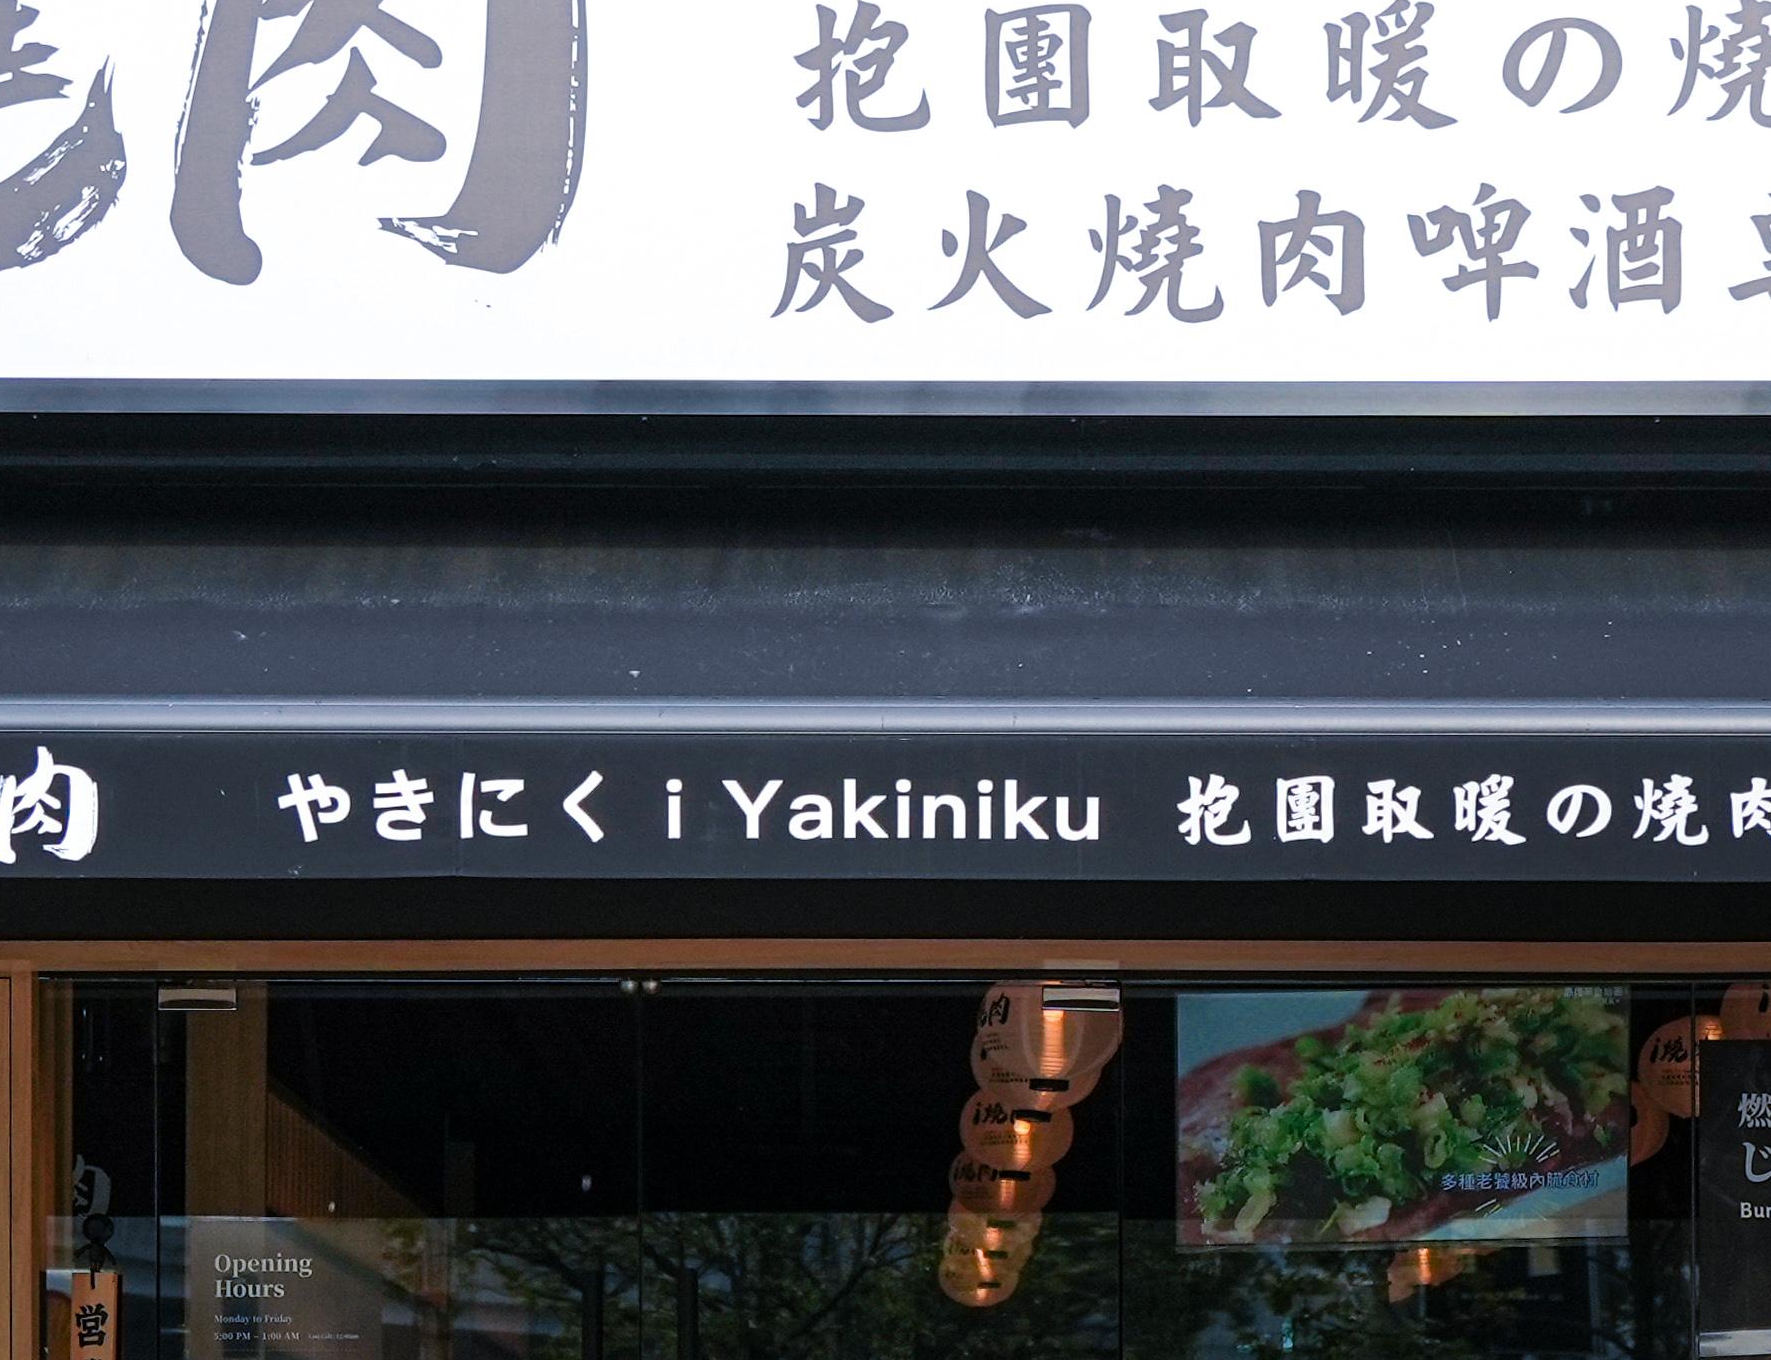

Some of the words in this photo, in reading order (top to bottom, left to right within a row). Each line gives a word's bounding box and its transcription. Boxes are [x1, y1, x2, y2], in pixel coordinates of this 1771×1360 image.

[278, 769, 603, 842] やきにく
[666, 779, 682, 838] i
[722, 779, 1099, 841] Yakiniku
[215, 1253, 312, 1278] Opening
[215, 1280, 285, 1298] Hours
[214, 1315, 250, 1325] Monday
[253, 1315, 262, 1323] to
[237, 1332, 251, 1340] PM
[263, 1332, 281, 1340] 1:00
[285, 1332, 299, 1340] AM
